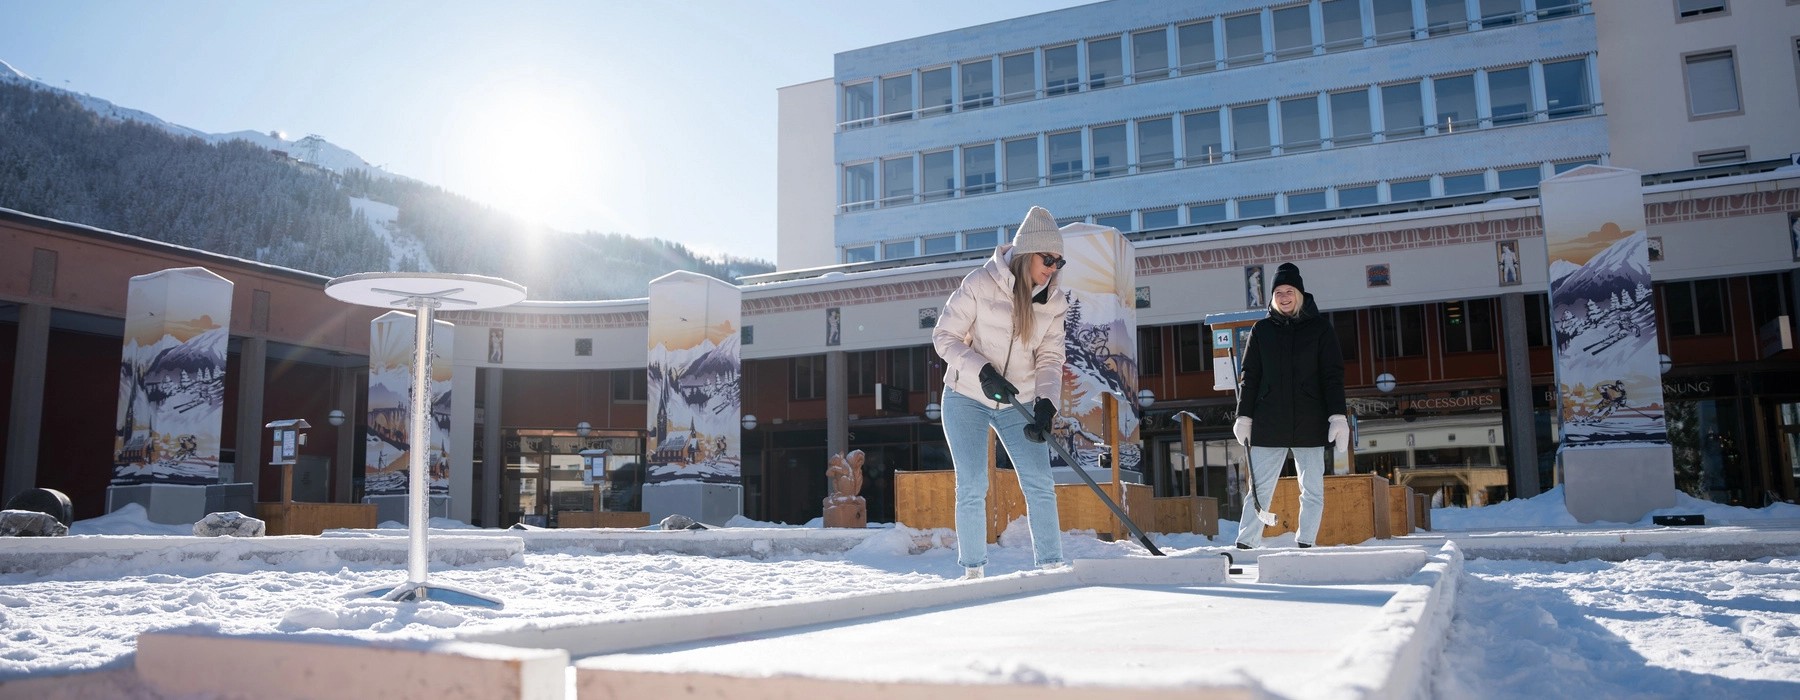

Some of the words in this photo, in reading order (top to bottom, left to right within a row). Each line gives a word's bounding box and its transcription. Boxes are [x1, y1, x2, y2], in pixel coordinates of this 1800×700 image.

[1218, 335, 1229, 343] 14
[1410, 395, 1494, 409] ACCESSOIRES
[506, 440, 540, 449] SPRT
